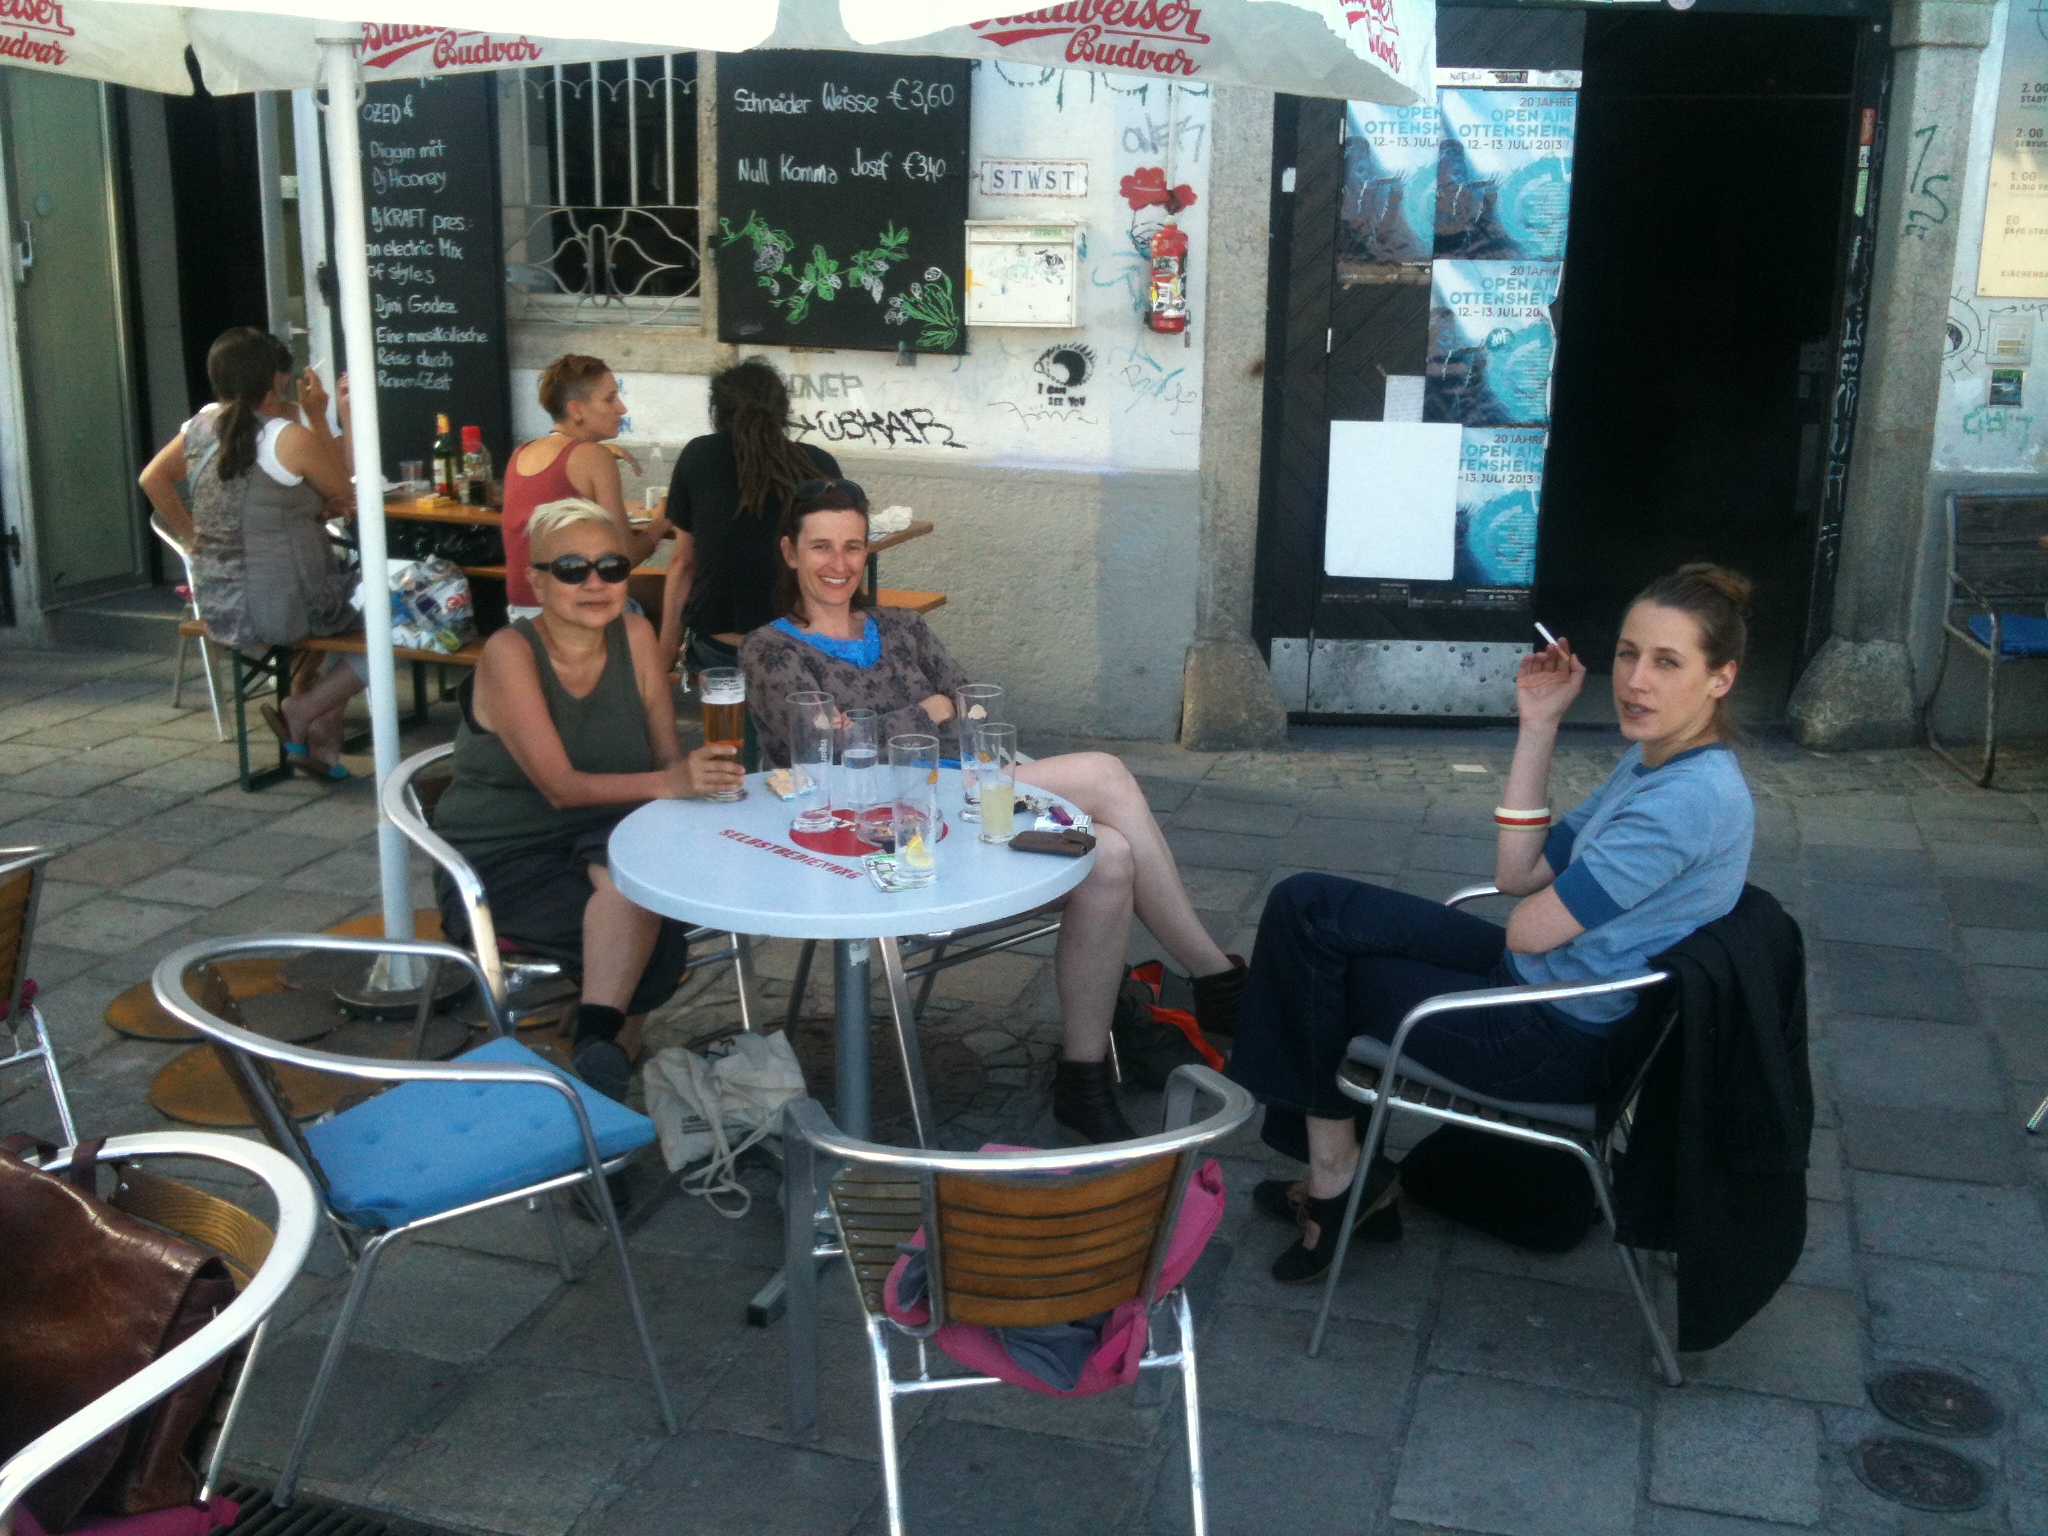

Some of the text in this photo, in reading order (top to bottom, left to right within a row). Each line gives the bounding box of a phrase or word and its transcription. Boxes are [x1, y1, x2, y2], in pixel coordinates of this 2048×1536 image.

[433, 30, 543, 69] Budvar
[1065, 24, 1201, 76] Budvar
[733, 88, 812, 114] Schneider
[822, 81, 879, 114] Weisse
[886, 78, 954, 115] €3,60
[1520, 97, 1534, 107] 20
[1491, 109, 1572, 122] OPEN AIR
[1459, 124, 1573, 138] OTTENSHEIM
[419, 139, 446, 158] mit
[1508, 139, 1533, 150] JULI
[1536, 139, 1563, 150] 2013
[738, 157, 770, 185] Null
[780, 153, 839, 185] Komma
[851, 147, 893, 181] Josef
[993, 169, 1075, 190] STWST
[388, 262, 436, 286] styles
[1510, 266, 1525, 276] 20
[1481, 278, 1528, 291] OPEN
[1498, 307, 1522, 318] JULI
[375, 326, 405, 344] Eine
[416, 349, 454, 367] durch
[1494, 433, 1508, 443] 20
[1466, 445, 1511, 458] OPEN
[1481, 473, 1505, 484] JULI
[1508, 474, 1534, 485] 2013
